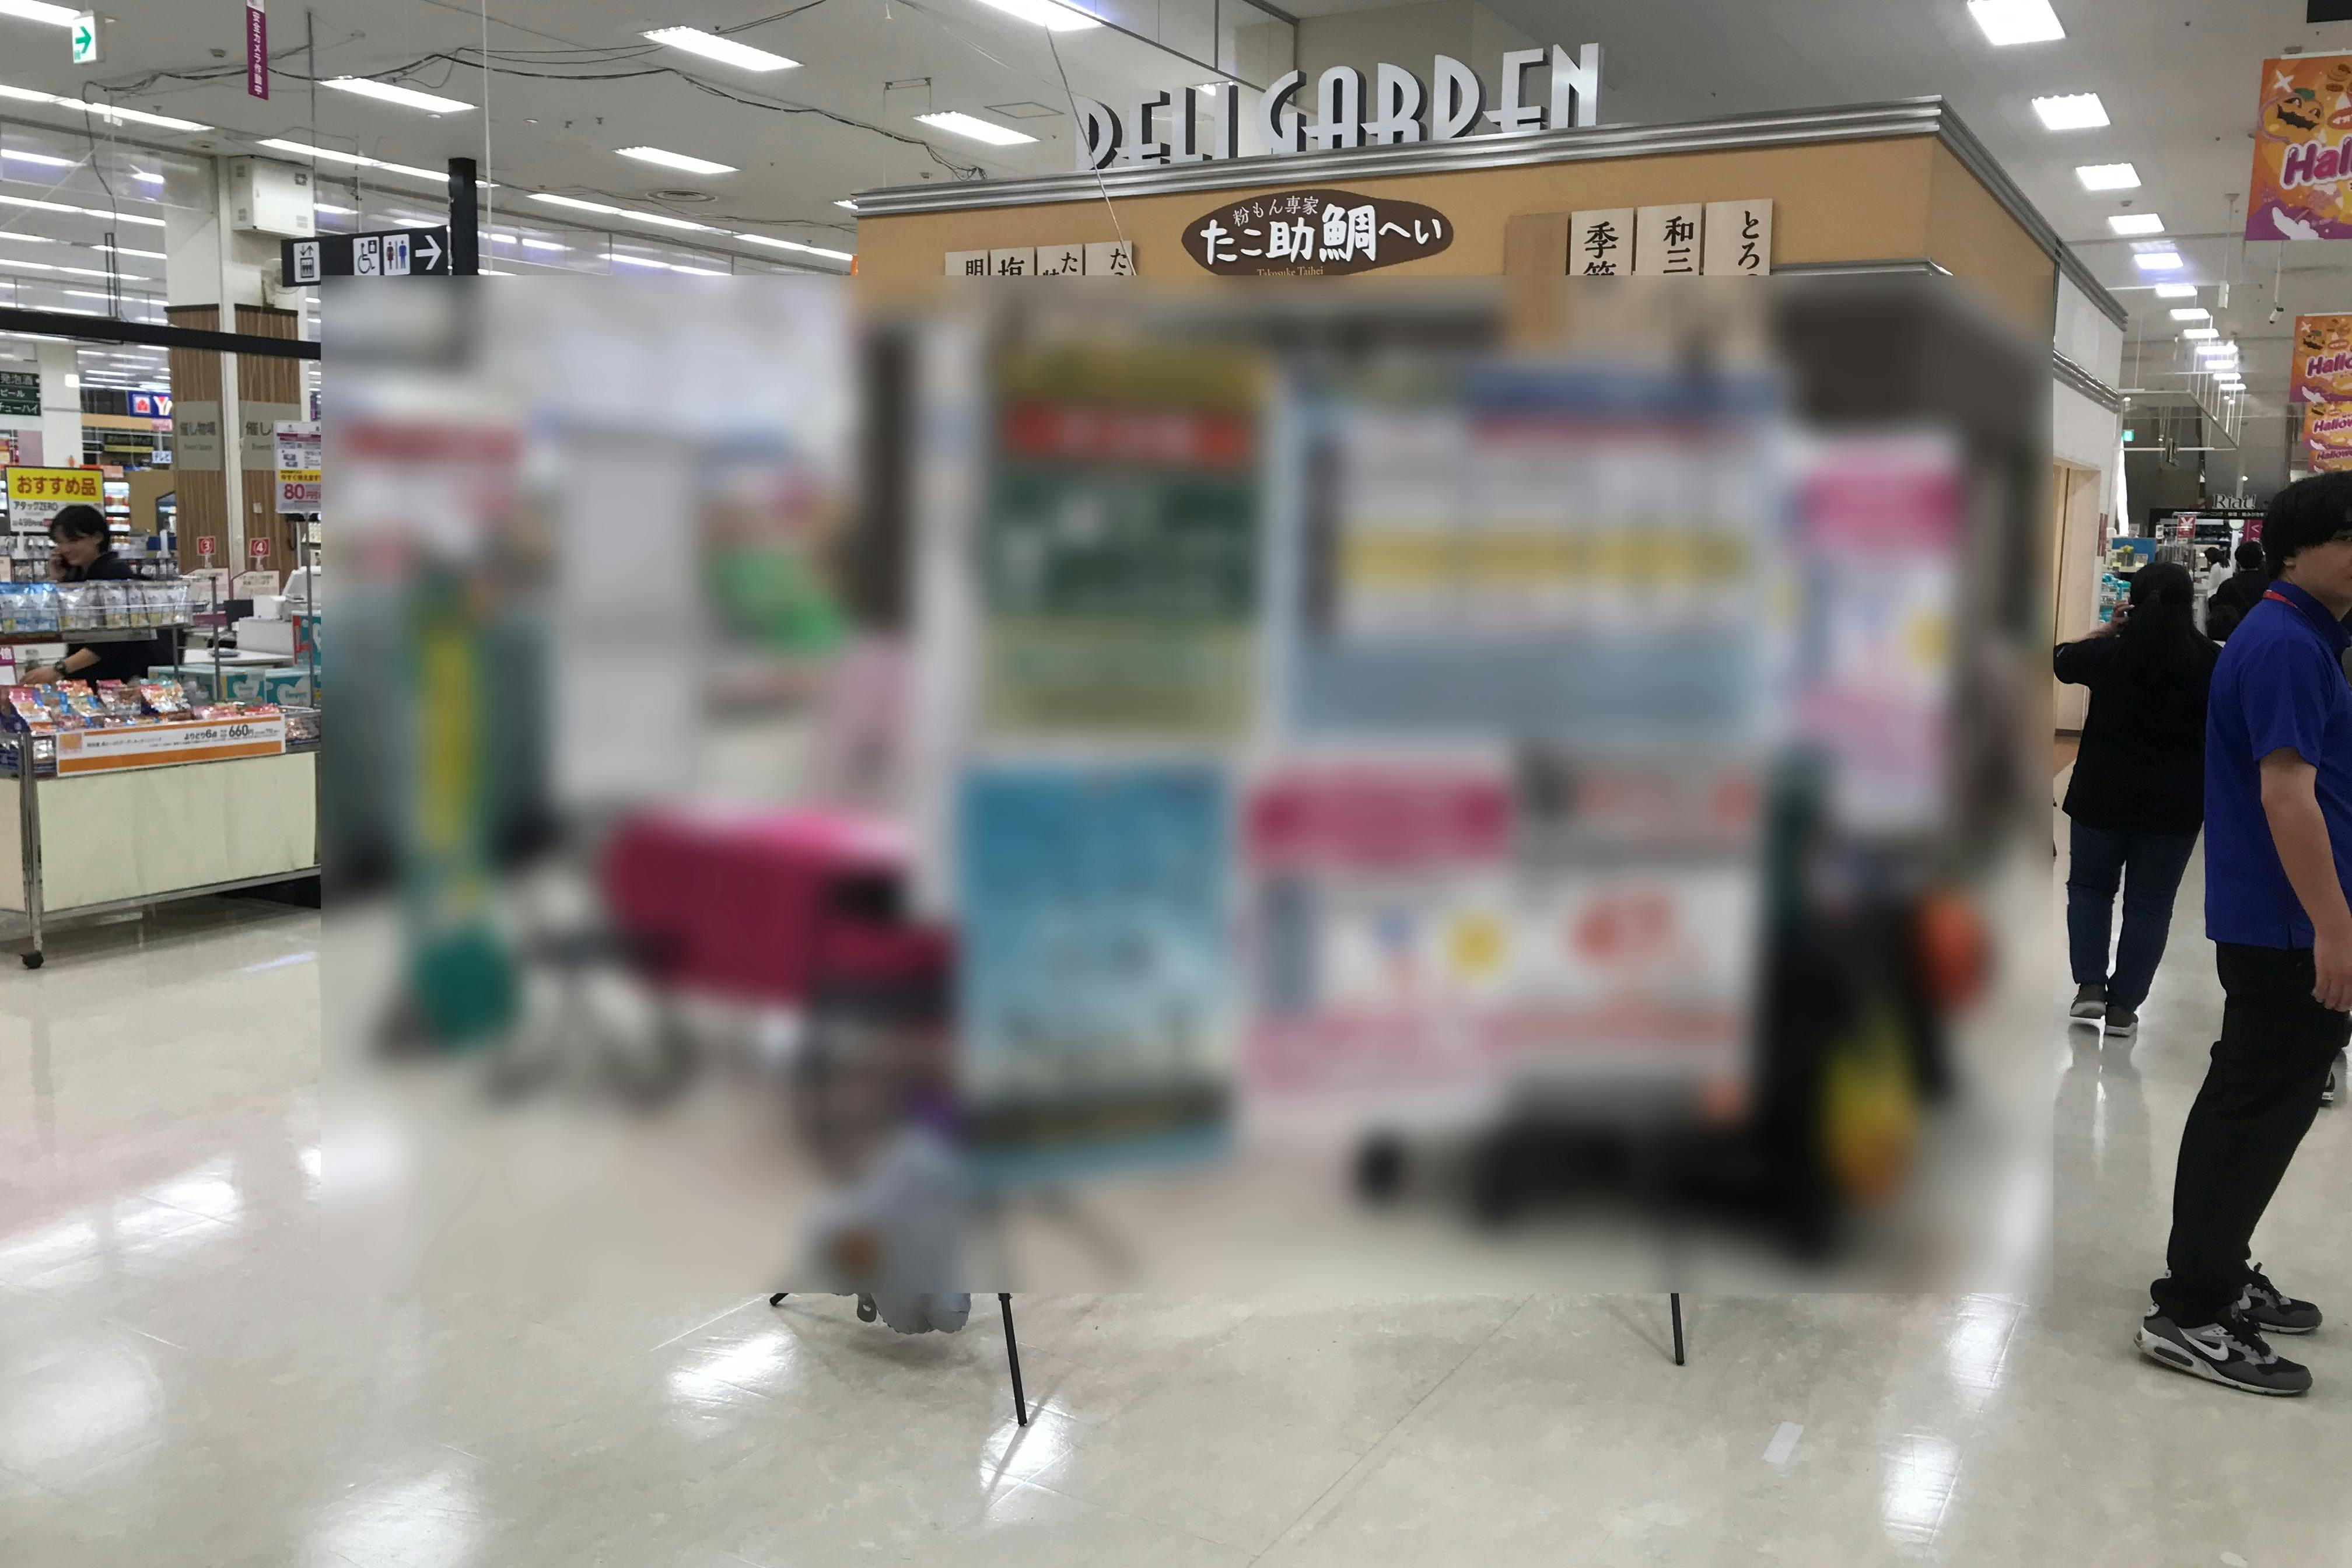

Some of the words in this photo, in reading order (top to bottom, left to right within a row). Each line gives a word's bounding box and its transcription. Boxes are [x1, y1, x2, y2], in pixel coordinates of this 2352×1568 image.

[1076, 84, 1238, 170] DELI
[1259, 42, 1603, 154] GARDEN
[1233, 195, 1319, 226] 粉もん専家
[1200, 203, 1441, 265] たこ助鯛へい
[1738, 211, 1760, 275] とろ
[1110, 248, 1128, 275] た
[246, 421, 274, 436] 催し
[17, 475, 96, 496] おすすめ品
[284, 483, 305, 500] 80
[2212, 494, 2257, 509] Riat!
